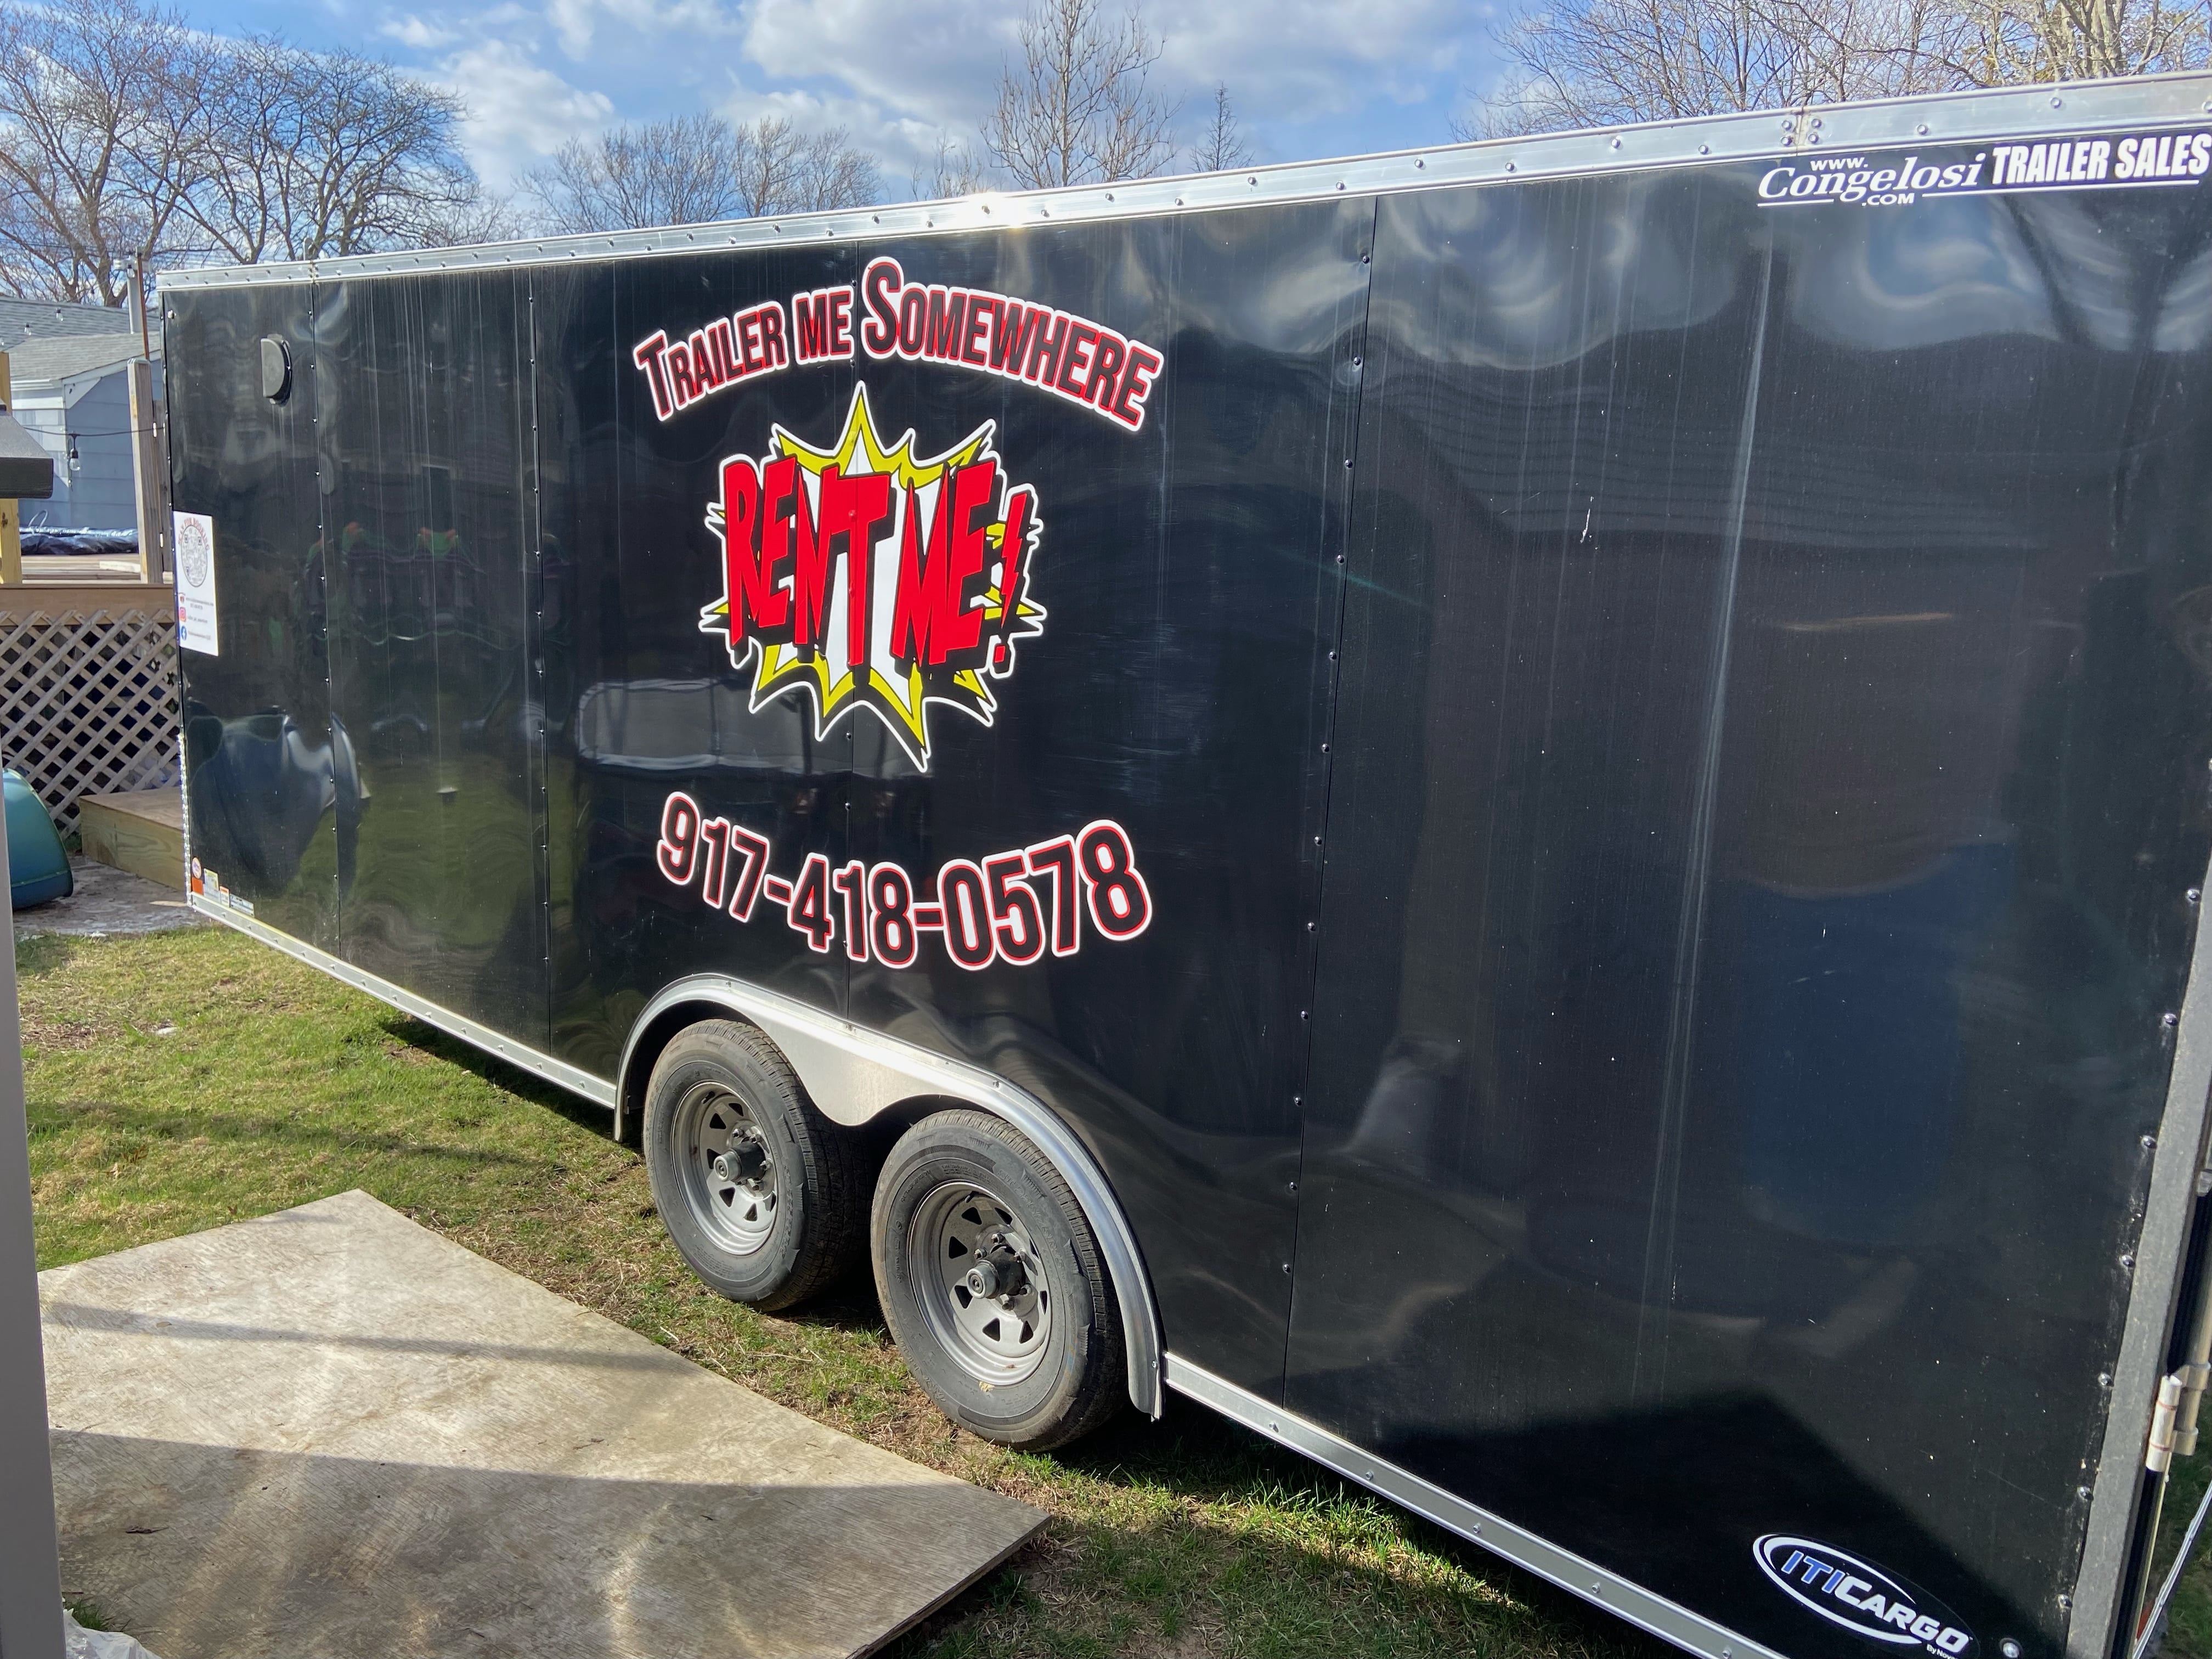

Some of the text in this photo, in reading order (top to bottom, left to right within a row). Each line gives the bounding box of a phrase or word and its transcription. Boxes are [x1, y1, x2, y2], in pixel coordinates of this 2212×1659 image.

[1758, 133, 2212, 202] Congelosi TRAILER SALES
[634, 256, 1164, 432] TRAILER ME SOMEWHERE
[724, 455, 1030, 669] RENT ME!
[657, 791, 1153, 970] 917-418-0578
